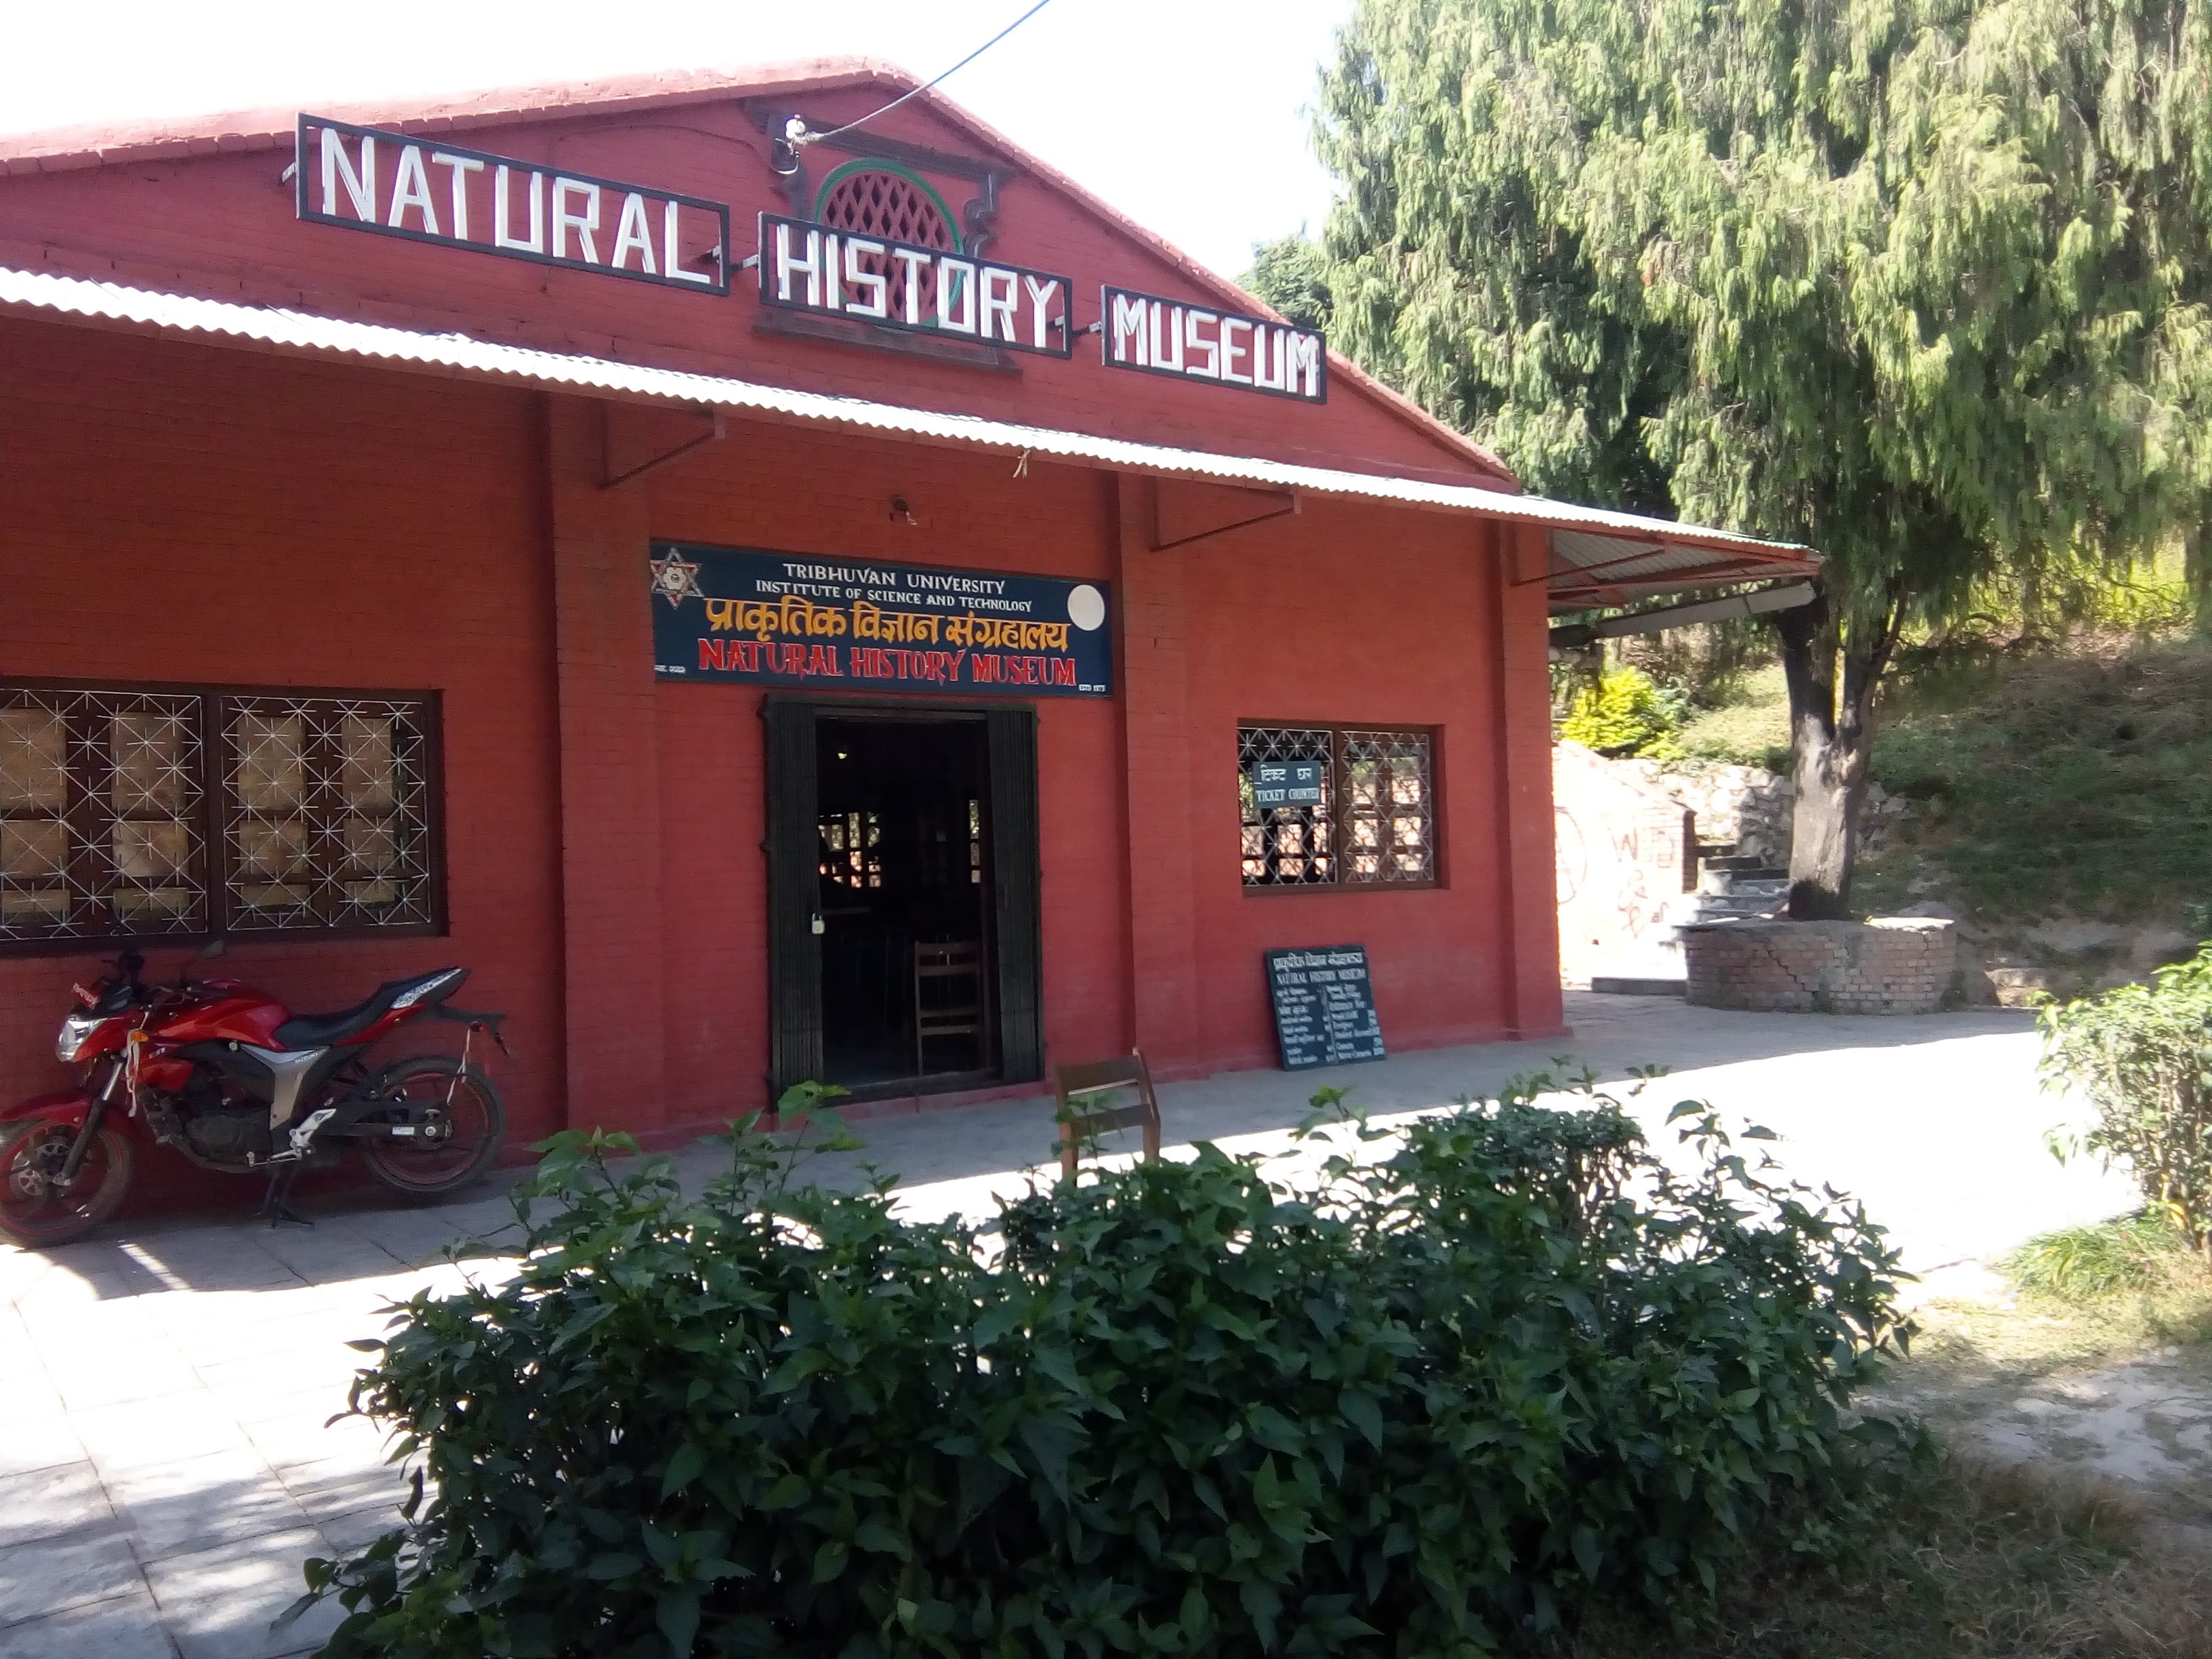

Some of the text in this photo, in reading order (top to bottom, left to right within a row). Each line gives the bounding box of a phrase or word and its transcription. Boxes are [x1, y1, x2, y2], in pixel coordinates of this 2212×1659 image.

[322, 127, 1318, 396] NATURAL HISTORY MUSEUM
[756, 579, 1032, 612] INSTITUTE OF SCIENCE AND TECHNOLOGY
[782, 563, 1005, 594] TRIBHUVAN UNIVERSITY
[703, 594, 1071, 653] प्राकृतिक विज्ञान संग्रहालय
[697, 638, 1077, 686] NATURAL HISTORY MUSEUM
[1256, 789, 1286, 802] TICKET
